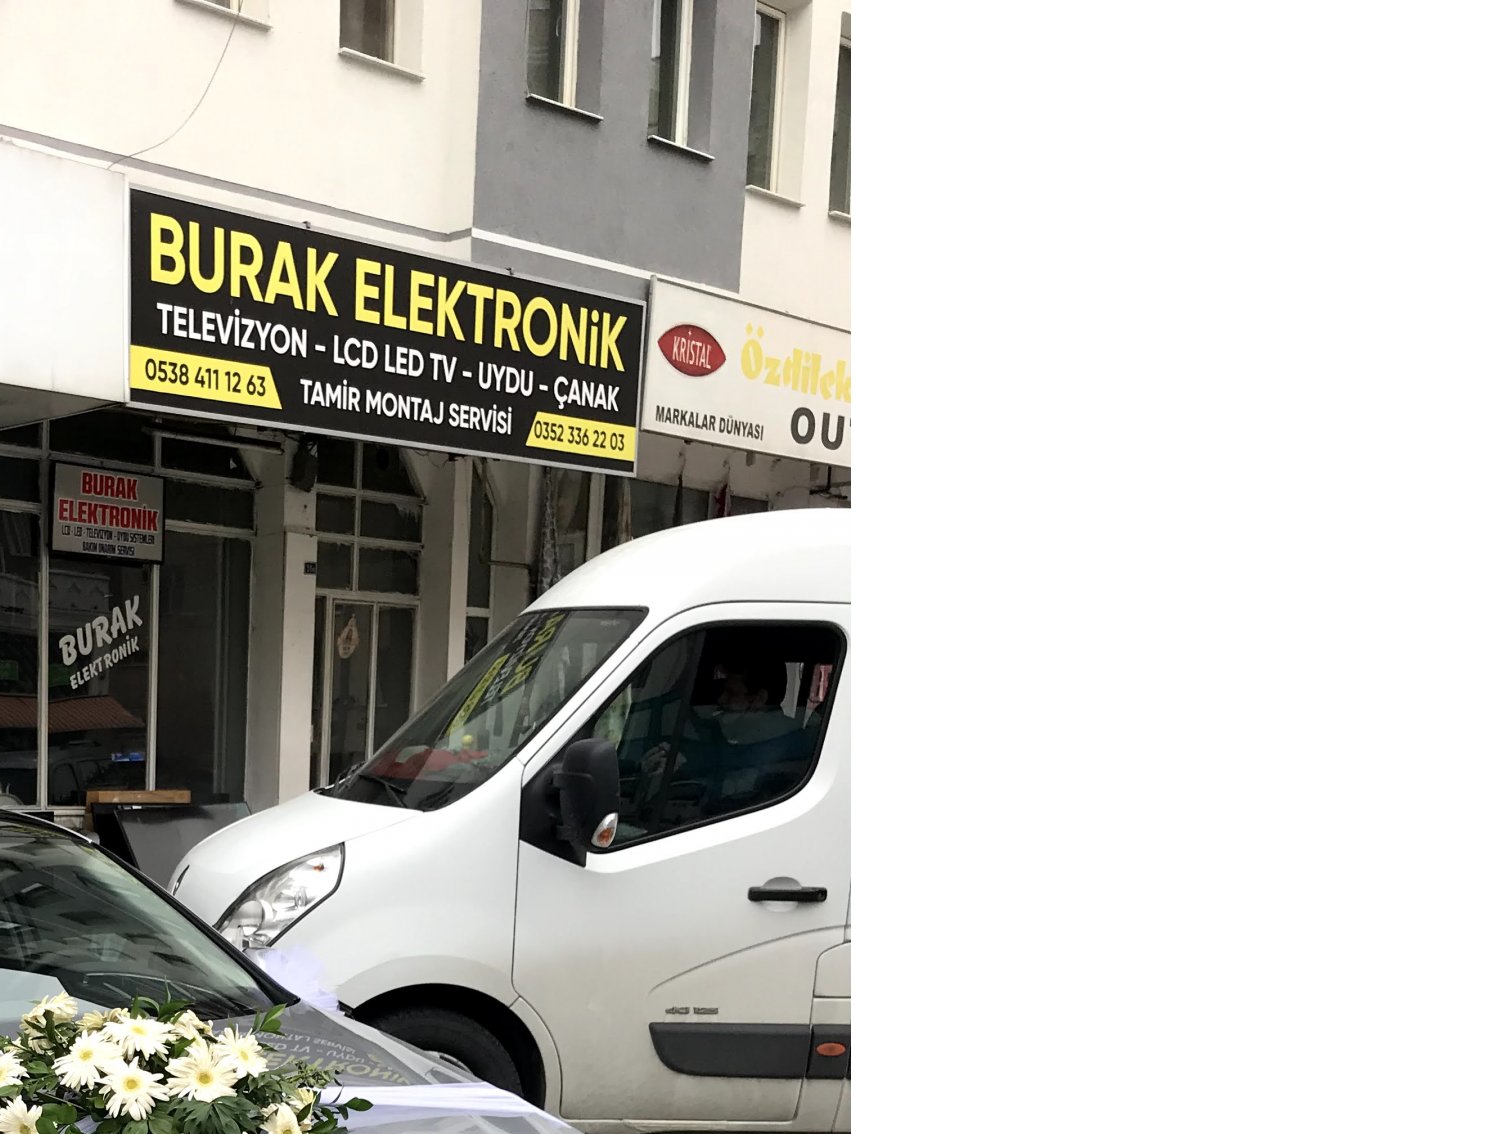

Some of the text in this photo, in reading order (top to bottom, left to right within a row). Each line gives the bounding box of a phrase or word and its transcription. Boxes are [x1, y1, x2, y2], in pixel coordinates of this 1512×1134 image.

[150, 212, 339, 317] BURAK
[145, 358, 266, 397] 0538 411 12 63
[156, 302, 308, 358] TELEVİZYON
[333, 335, 379, 369] LCD
[384, 343, 425, 378] LED
[430, 352, 458, 383] TV
[478, 361, 534, 397] UYDU
[553, 375, 620, 412] ÇANAK
[740, 321, 851, 404] Özdilek
[299, 378, 513, 435] TAMİR MONTAJ SERVİSİ
[655, 405, 764, 441] MARKALAR DÜNYASI
[790, 406, 851, 451] OU
[534, 420, 625, 452] 0352 336 22 03
[81, 471, 138, 501] BURAK
[58, 498, 159, 532] ELEKTRONİK
[59, 595, 143, 666] BURAK
